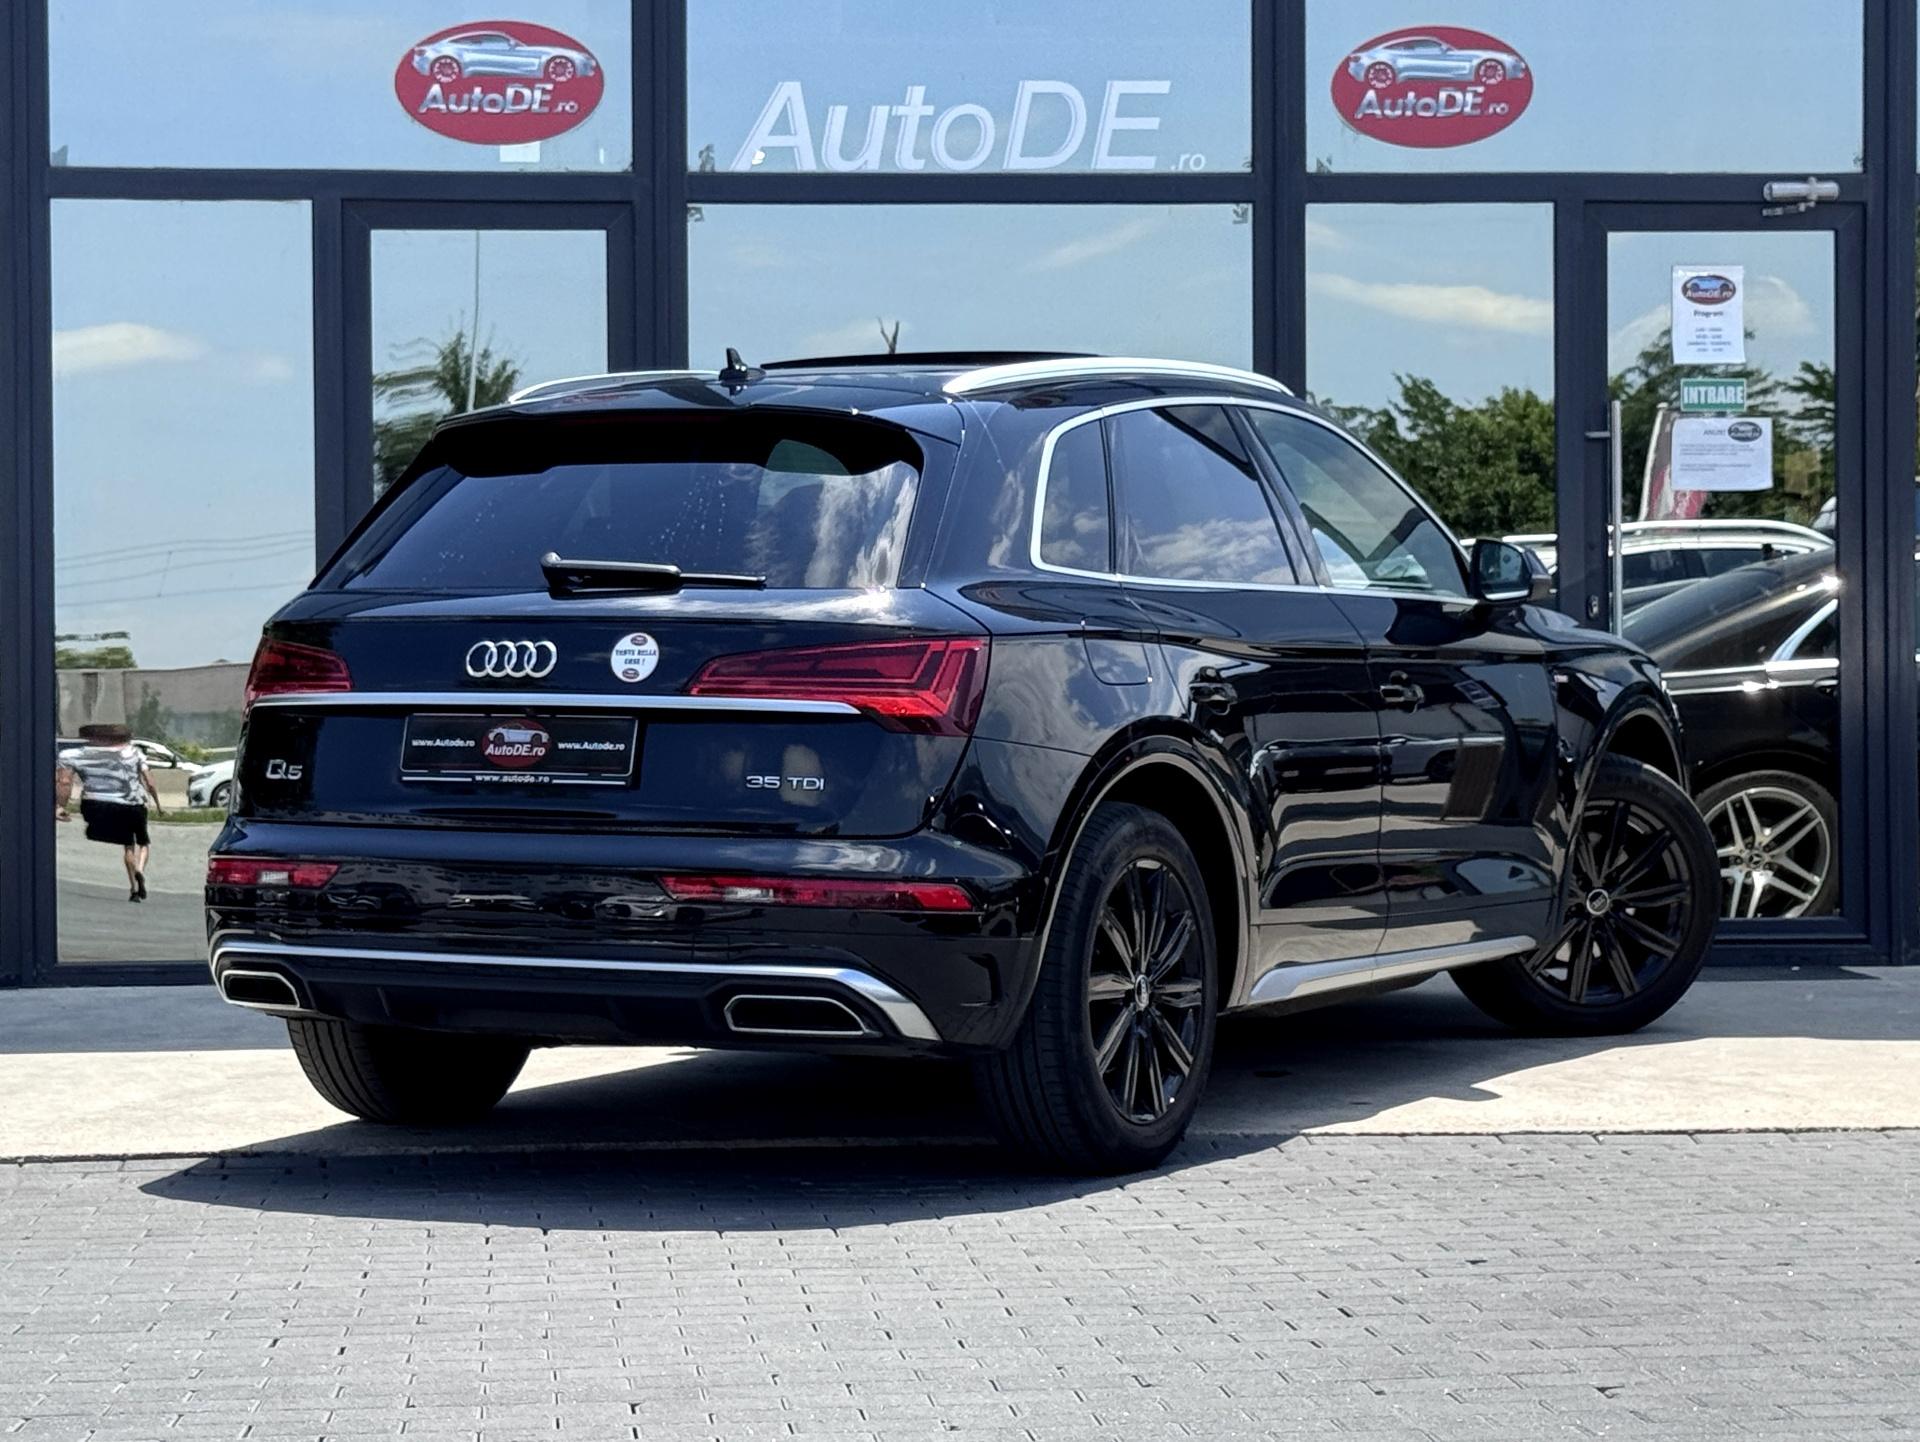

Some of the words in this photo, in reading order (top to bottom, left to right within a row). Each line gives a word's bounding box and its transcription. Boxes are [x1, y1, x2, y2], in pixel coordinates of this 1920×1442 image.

[1683, 386, 1744, 404] INTRARE
[484, 744, 546, 757] AutoDE.ro
[266, 759, 303, 779] Q5
[746, 775, 780, 788] 35
[787, 777, 825, 790] TDI
